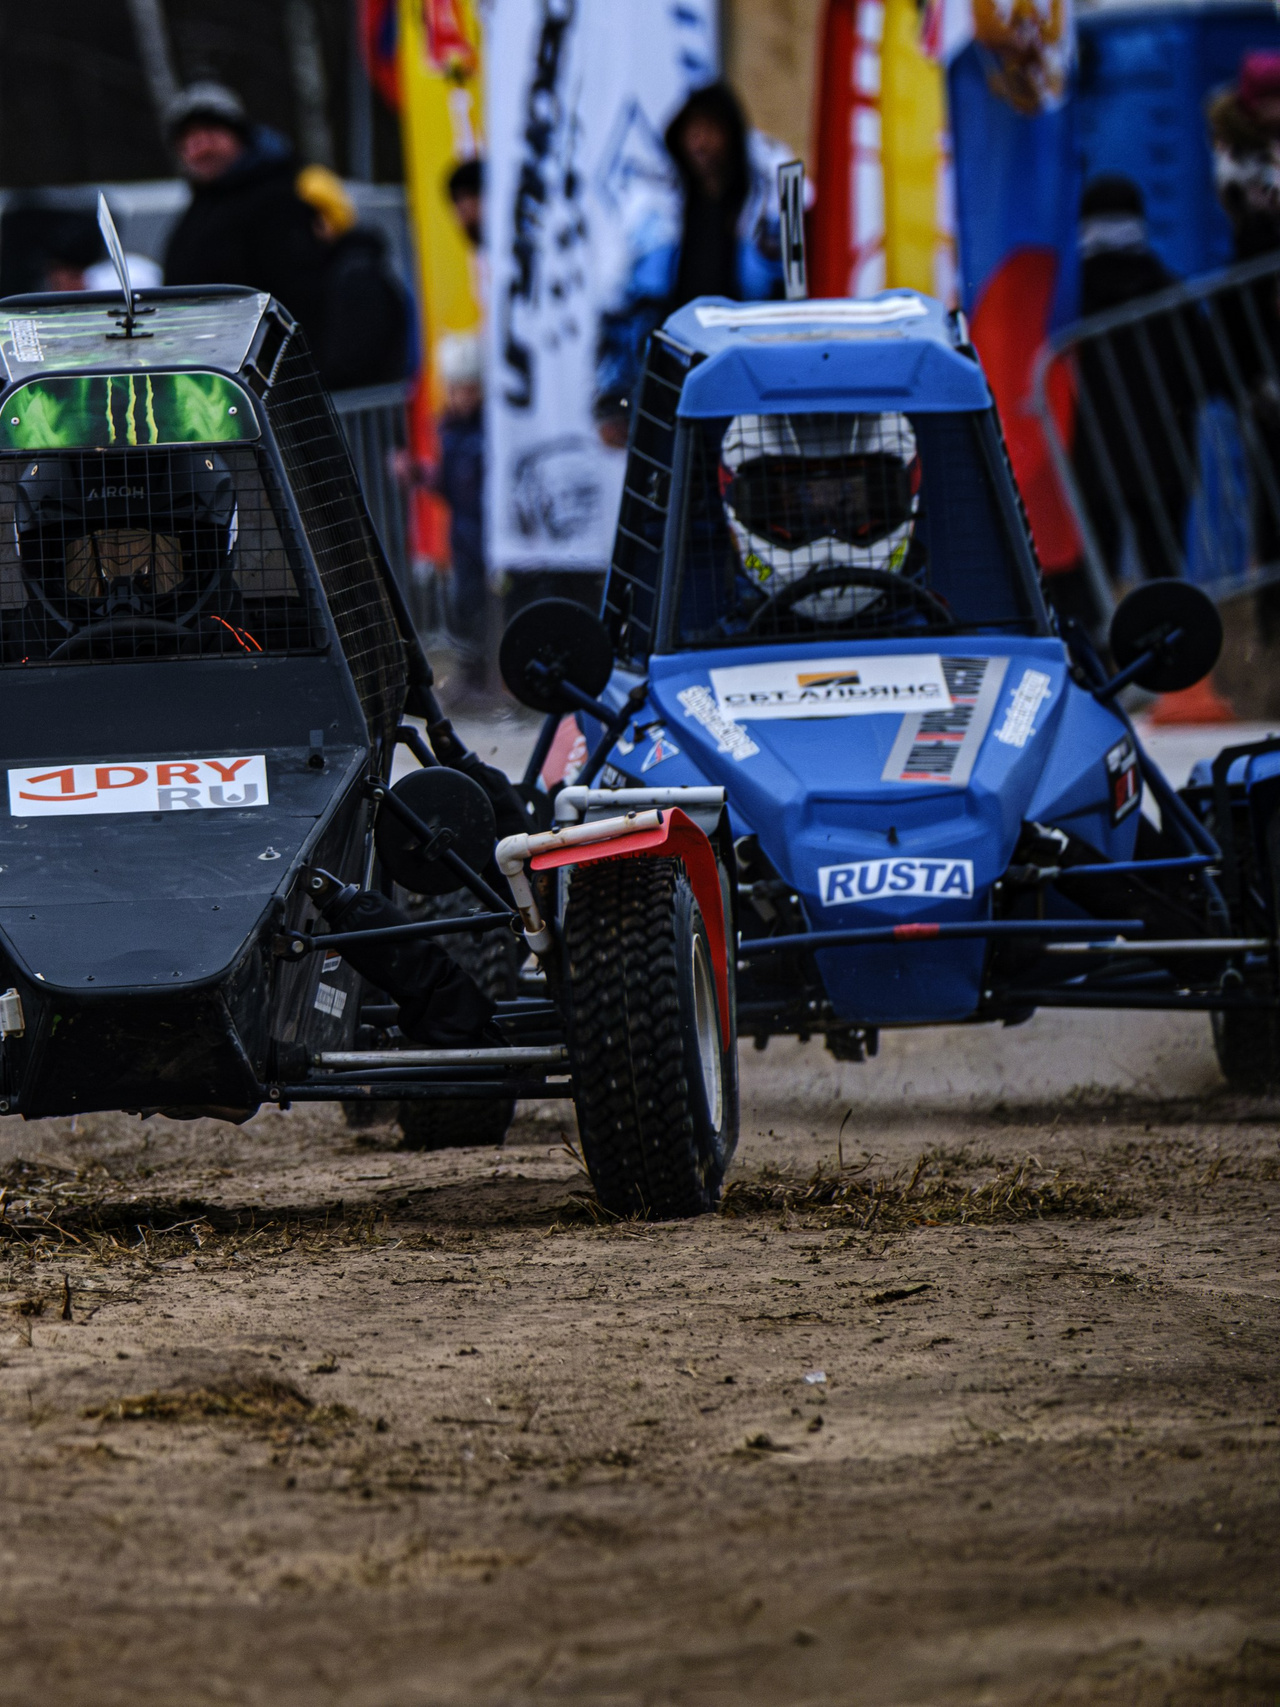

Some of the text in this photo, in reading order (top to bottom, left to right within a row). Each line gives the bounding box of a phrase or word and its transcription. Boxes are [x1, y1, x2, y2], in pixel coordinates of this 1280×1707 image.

[87, 486, 144, 501] AIROH
[158, 782, 259, 810] RU
[826, 861, 970, 902] RUSTA
